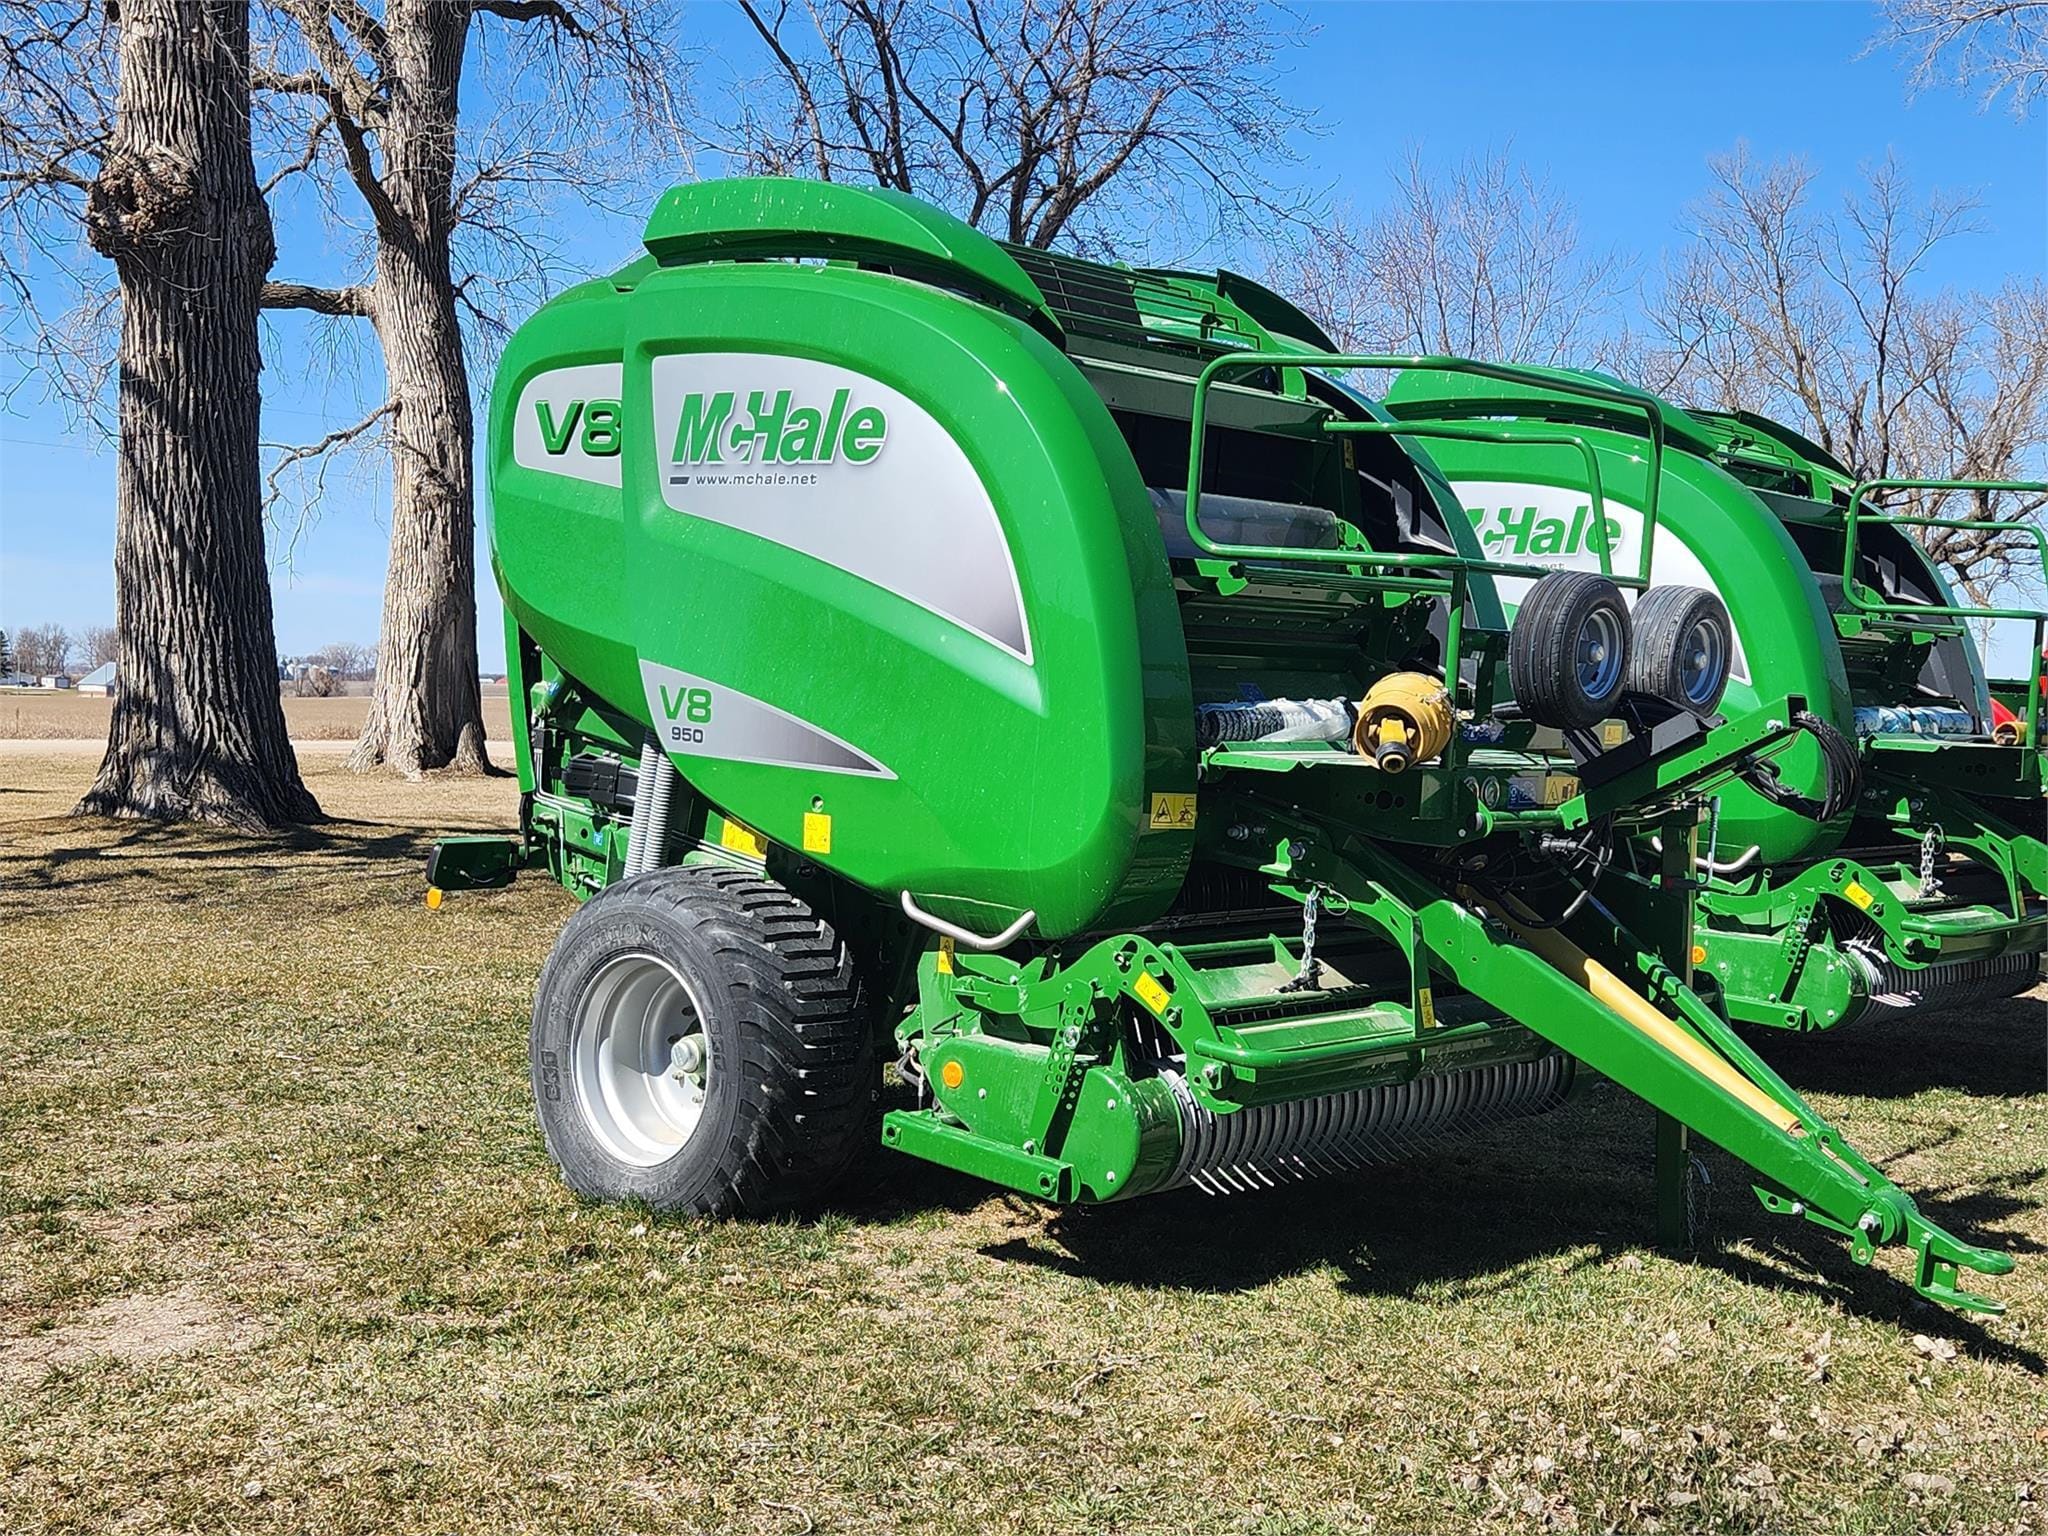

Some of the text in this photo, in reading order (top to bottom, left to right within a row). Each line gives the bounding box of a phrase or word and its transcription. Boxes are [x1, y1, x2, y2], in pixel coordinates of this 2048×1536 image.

[535, 399, 621, 456] V8
[672, 388, 887, 465] McHale
[695, 474, 817, 486] www.mchale.net
[660, 685, 713, 723] V8
[671, 727, 703, 743] 950
